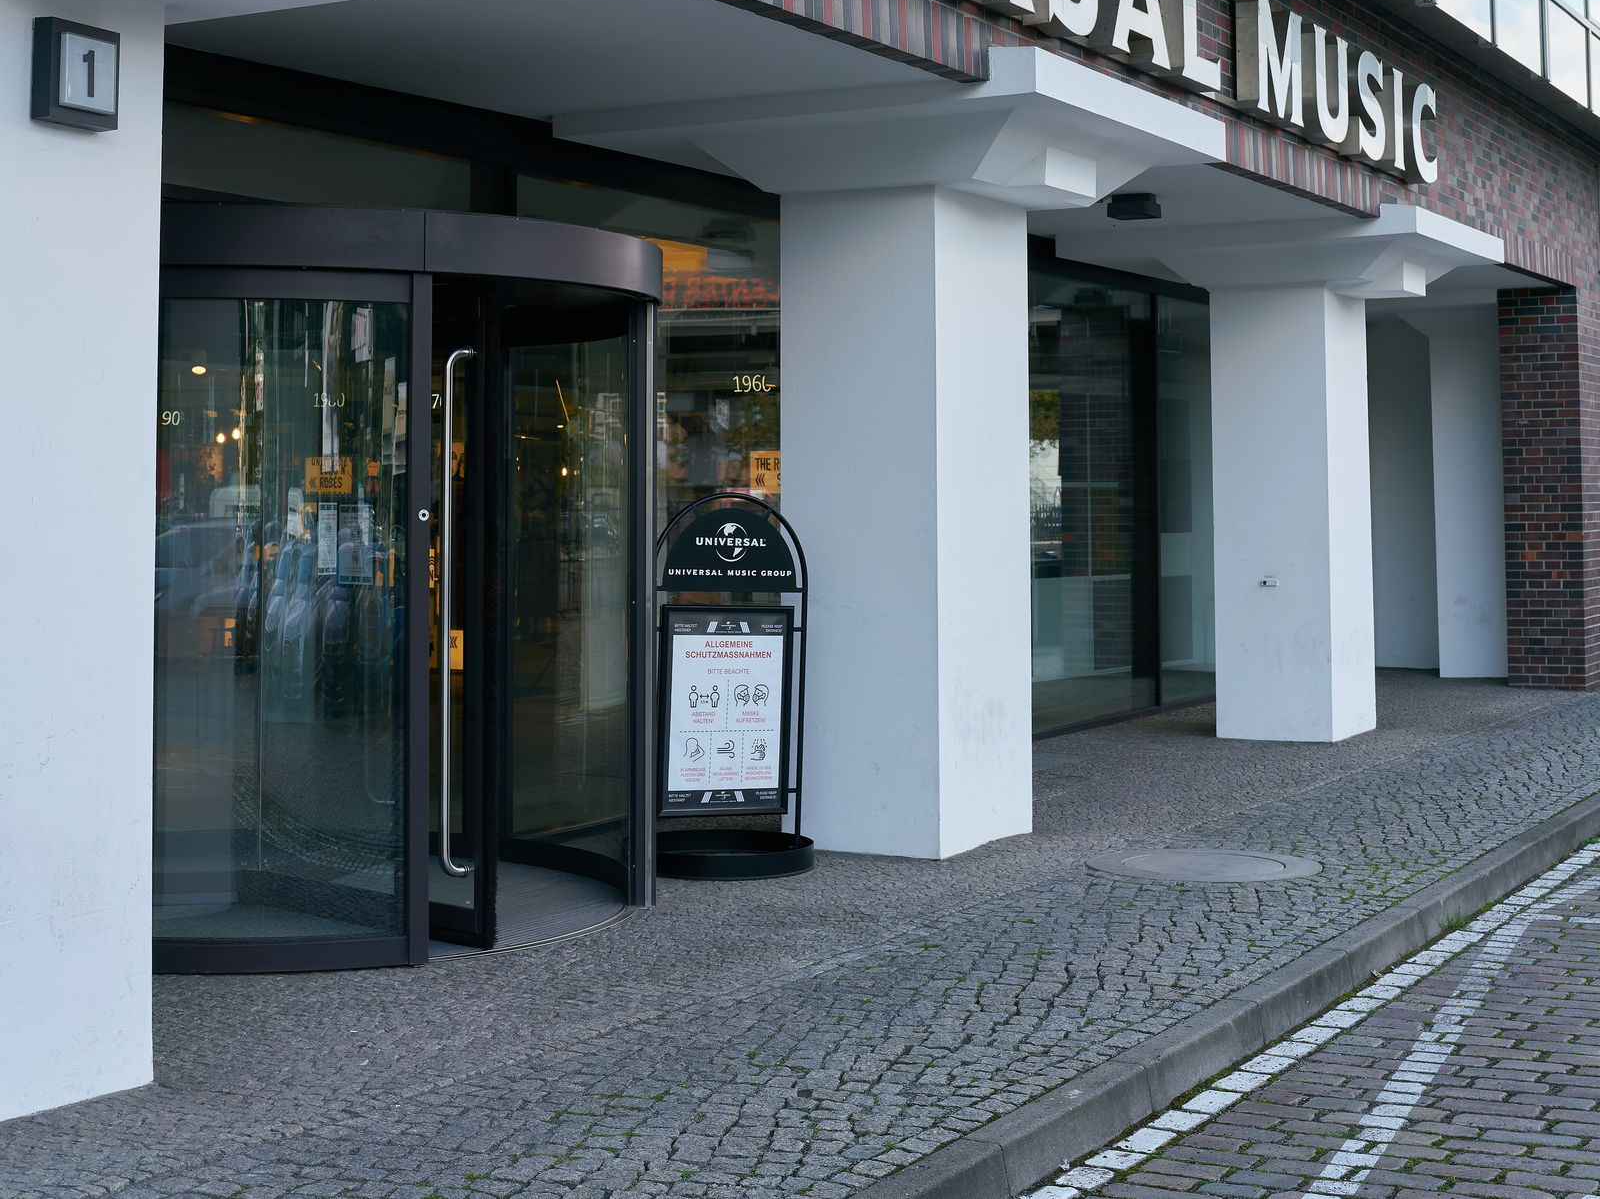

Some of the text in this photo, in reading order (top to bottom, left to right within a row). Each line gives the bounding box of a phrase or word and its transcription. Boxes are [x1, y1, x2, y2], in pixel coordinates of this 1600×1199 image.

[83, 49, 95, 98] 1
[754, 457, 772, 470] THE
[320, 476, 342, 488] ROSES
[695, 537, 766, 547] UNIVERSAL
[685, 651, 772, 659] SCHUTZMASSNAHMEN
